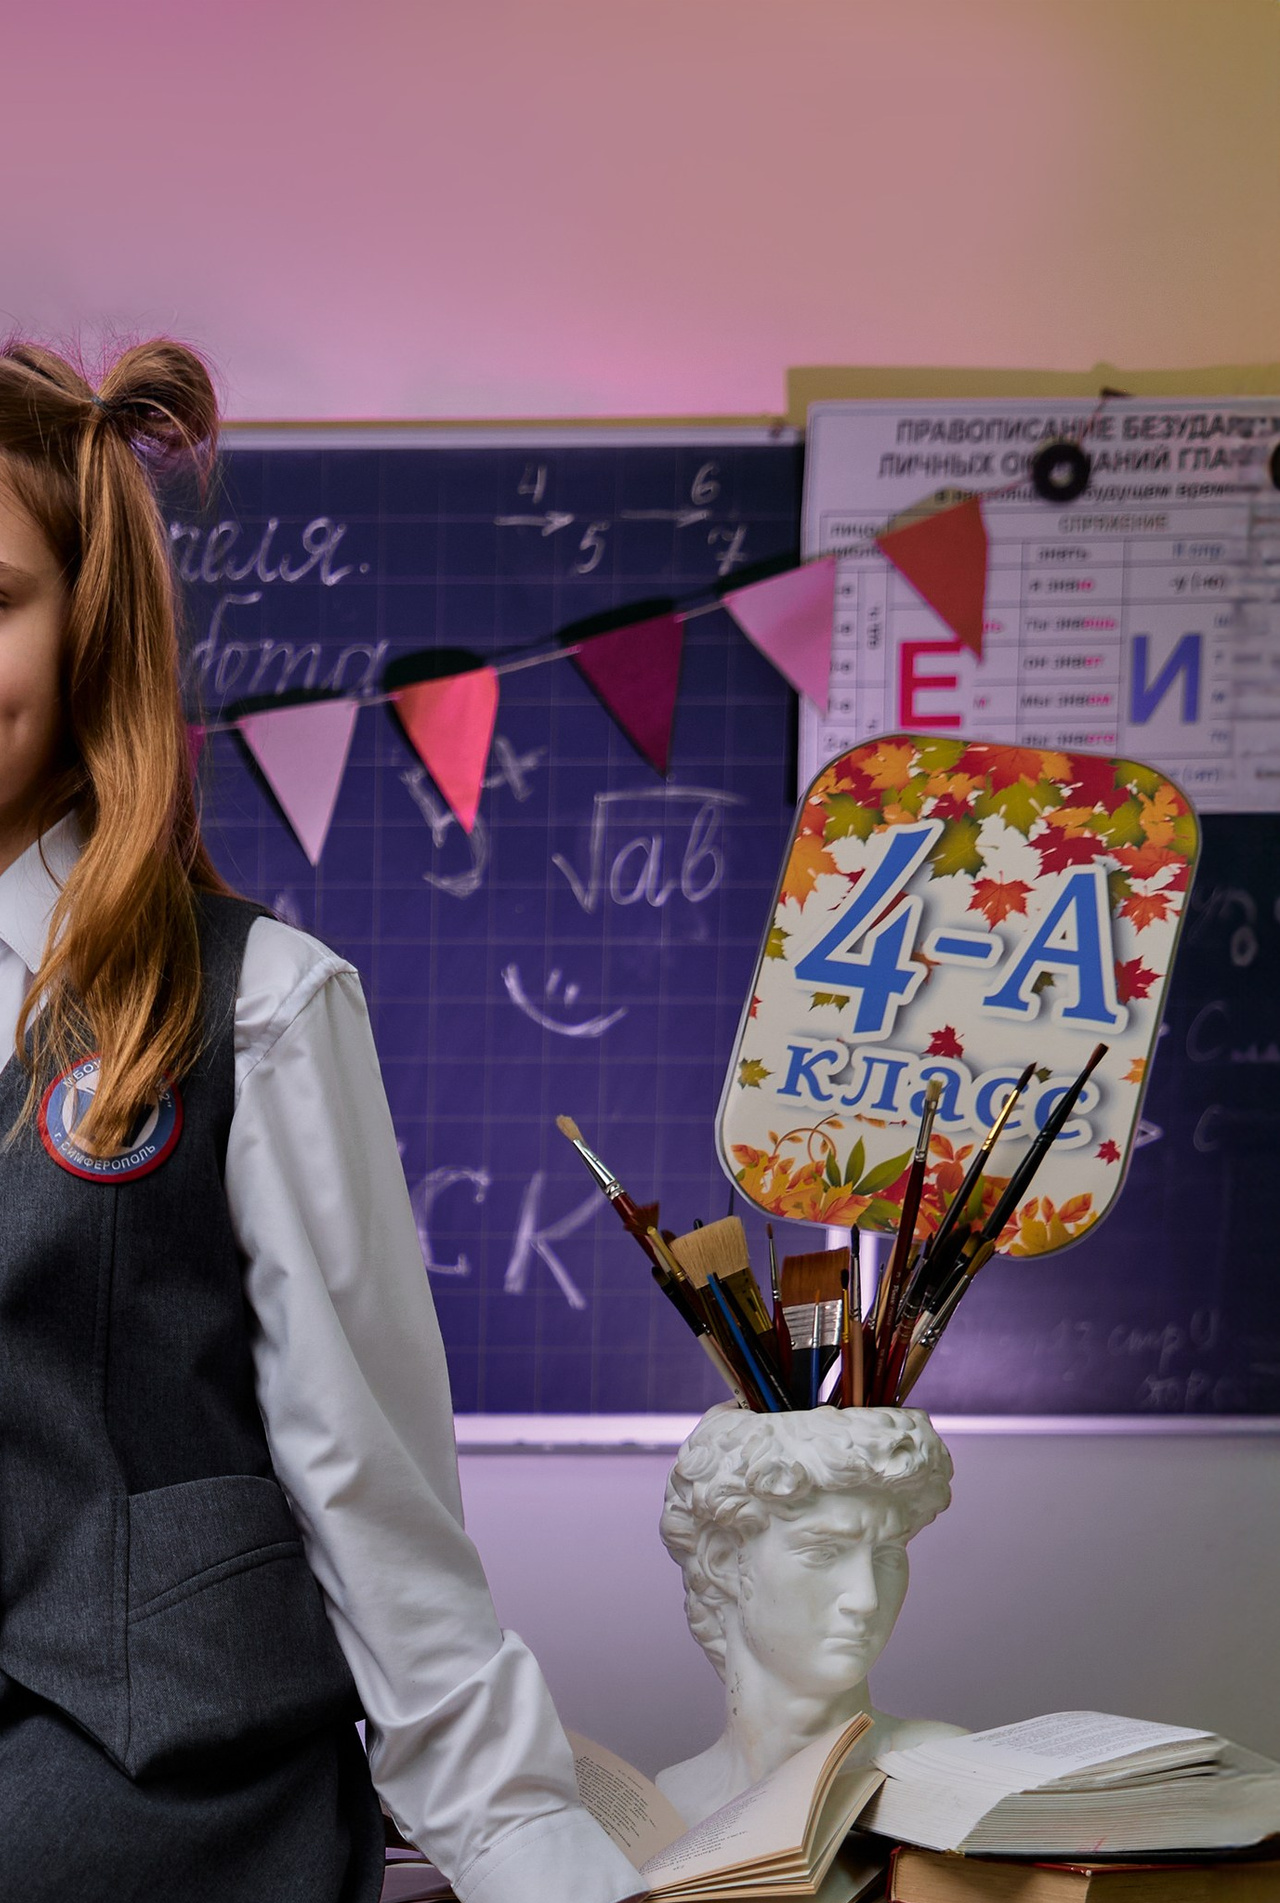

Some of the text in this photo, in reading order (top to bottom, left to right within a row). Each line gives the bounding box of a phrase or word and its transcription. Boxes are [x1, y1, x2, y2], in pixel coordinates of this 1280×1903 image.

[878, 450, 994, 479] ЛИЧНЫХ
[1000, 446, 1173, 477] ОКАНИЙ
[896, 413, 1280, 446] ПРАВОПИСАНИЕ БЕЗУДАР
[517, 461, 720, 504] 4 6
[188, 590, 392, 697] бота
[899, 640, 963, 729] Е
[1129, 632, 1203, 725] И
[794, 825, 1121, 1036] 4-А
[776, 1043, 1091, 1141] класс
